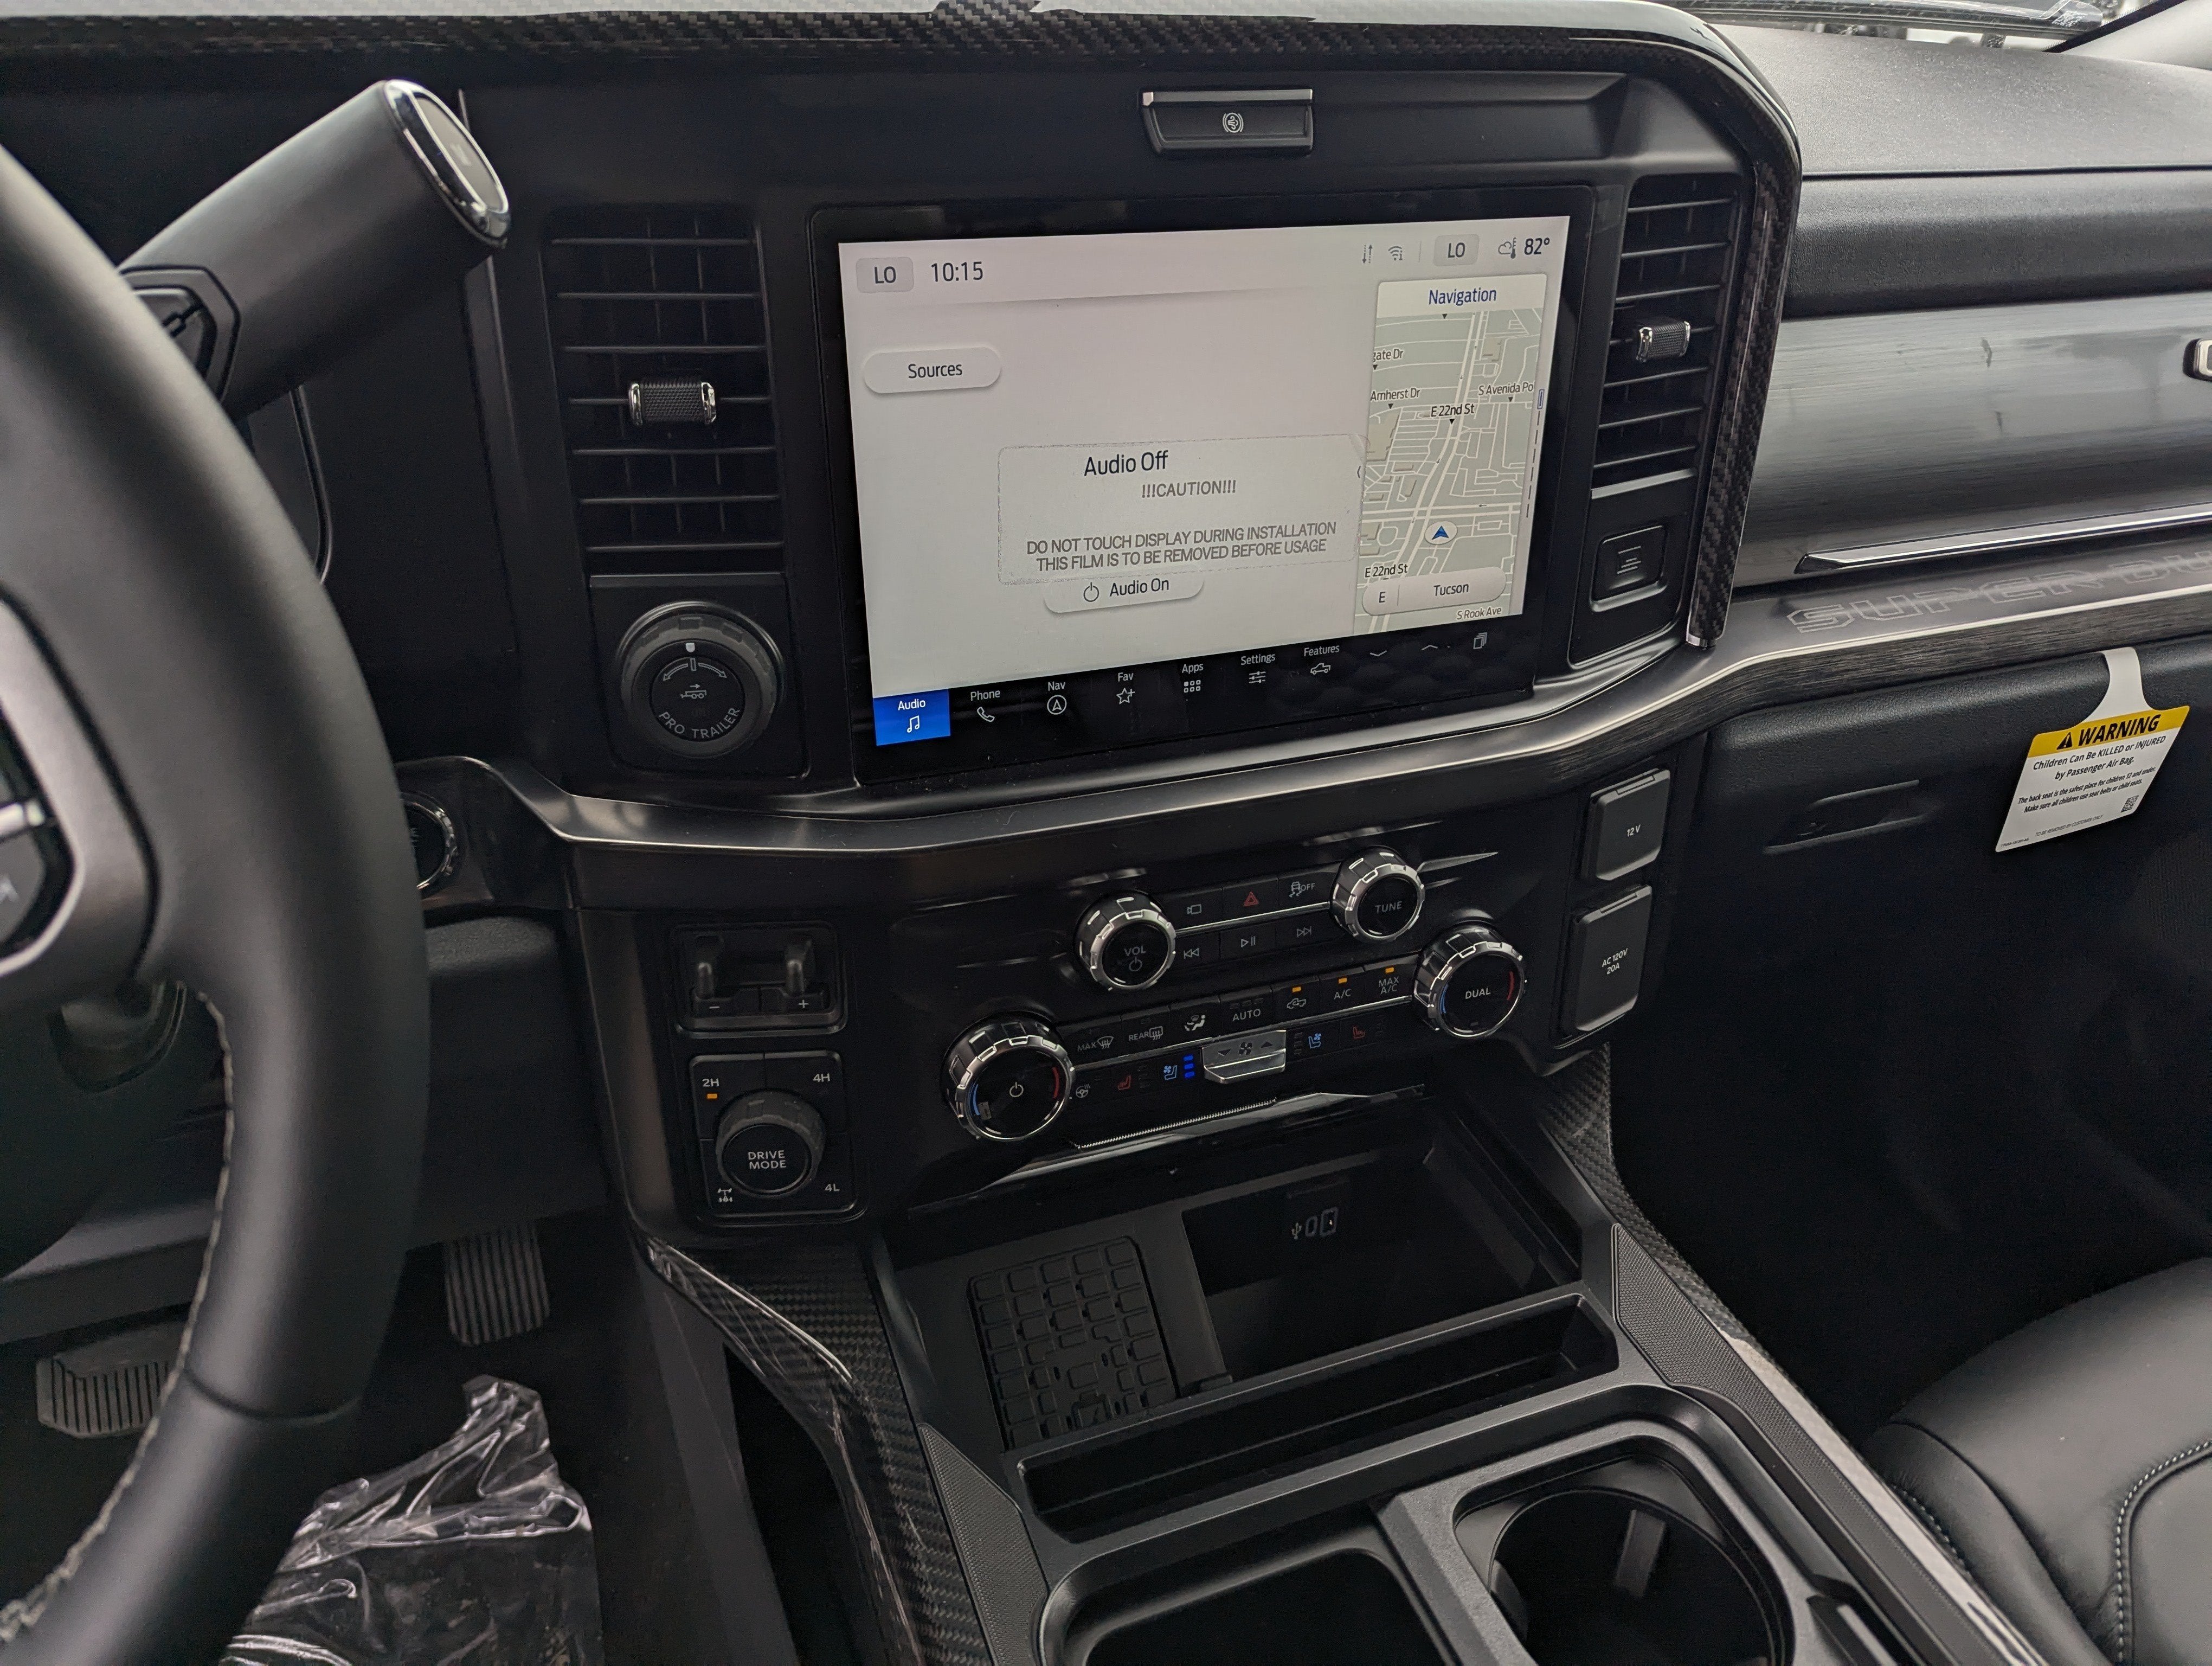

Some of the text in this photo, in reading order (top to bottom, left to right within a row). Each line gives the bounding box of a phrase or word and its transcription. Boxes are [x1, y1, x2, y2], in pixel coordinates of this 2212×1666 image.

[1448, 242, 1465, 258] LO
[1524, 238, 1550, 255] 82°
[874, 266, 897, 284] LO
[931, 261, 983, 283] 10:15
[1429, 288, 1497, 306] Navigation
[1393, 349, 1404, 359] Dr
[908, 363, 963, 379] Sources
[1370, 388, 1420, 401] Amherst Dr
[1478, 385, 1485, 395] S
[1486, 383, 1521, 394] Avenida
[1431, 403, 1475, 417] E 22nd St
[1084, 450, 1168, 476] Audio Off
[1142, 480, 1236, 497] !!!CAUTION!!!
[1027, 522, 1336, 554] DO NOT TOUCH DISPLAY DURING INSTALLATION
[1037, 539, 1326, 571] THIS FILM IS TO BE REMOVED BEFORE USAGE
[1365, 564, 1408, 578] E 22nd St
[1109, 578, 1169, 597] Audio On
[1433, 584, 1469, 596] Tucson
[1379, 592, 1385, 603] E
[1787, 571, 2105, 633] SUPER
[1457, 607, 1501, 620] S Rook Ave
[1304, 644, 1340, 657] Features
[1240, 653, 1276, 666] Settings
[1182, 663, 1204, 674] Apps
[1118, 672, 1134, 682] Fav
[1047, 681, 1066, 691] Nav
[970, 689, 1000, 701] Phone
[898, 699, 926, 711] Audio
[659, 708, 740, 739] PRO TRAILER
[2078, 714, 2162, 746] WARNING
[2033, 757, 2068, 770] Children
[2069, 754, 2084, 764] Can
[2086, 752, 2097, 760] Be
[2098, 745, 2124, 757] KILLED
[2135, 736, 2166, 749] INJURED
[2054, 756, 2134, 781] by Passenger Air Bag.
[2028, 793, 2041, 802] back
[2068, 785, 2084, 793] safest
[2083, 782, 2097, 791] place
[2106, 775, 2125, 784] children
[2132, 770, 2142, 778] and
[2024, 804, 2039, 813] Make
[2059, 795, 2079, 805] children
[2100, 787, 2111, 795] belts
[2118, 781, 2131, 790] child
[1301, 883, 1315, 892] OFF
[1375, 901, 1403, 913] TUNE
[1124, 945, 1146, 956] VOL
[1602, 948, 1628, 967] AC 120V
[1606, 963, 1621, 975] 20A
[1379, 977, 1399, 988] MAX
[1380, 983, 1398, 995] A/C
[1334, 988, 1352, 1001] A/C
[1465, 987, 1491, 1000] DUAL
[1232, 1009, 1261, 1023] AUTO
[1129, 1031, 1149, 1041] REAR
[1077, 1041, 1096, 1052] MAX
[703, 1079, 719, 1087] 2H
[813, 1073, 831, 1083] 4H
[748, 1150, 785, 1161] DRIVE
[749, 1159, 787, 1170] MODE
[825, 1184, 840, 1193] 4L
